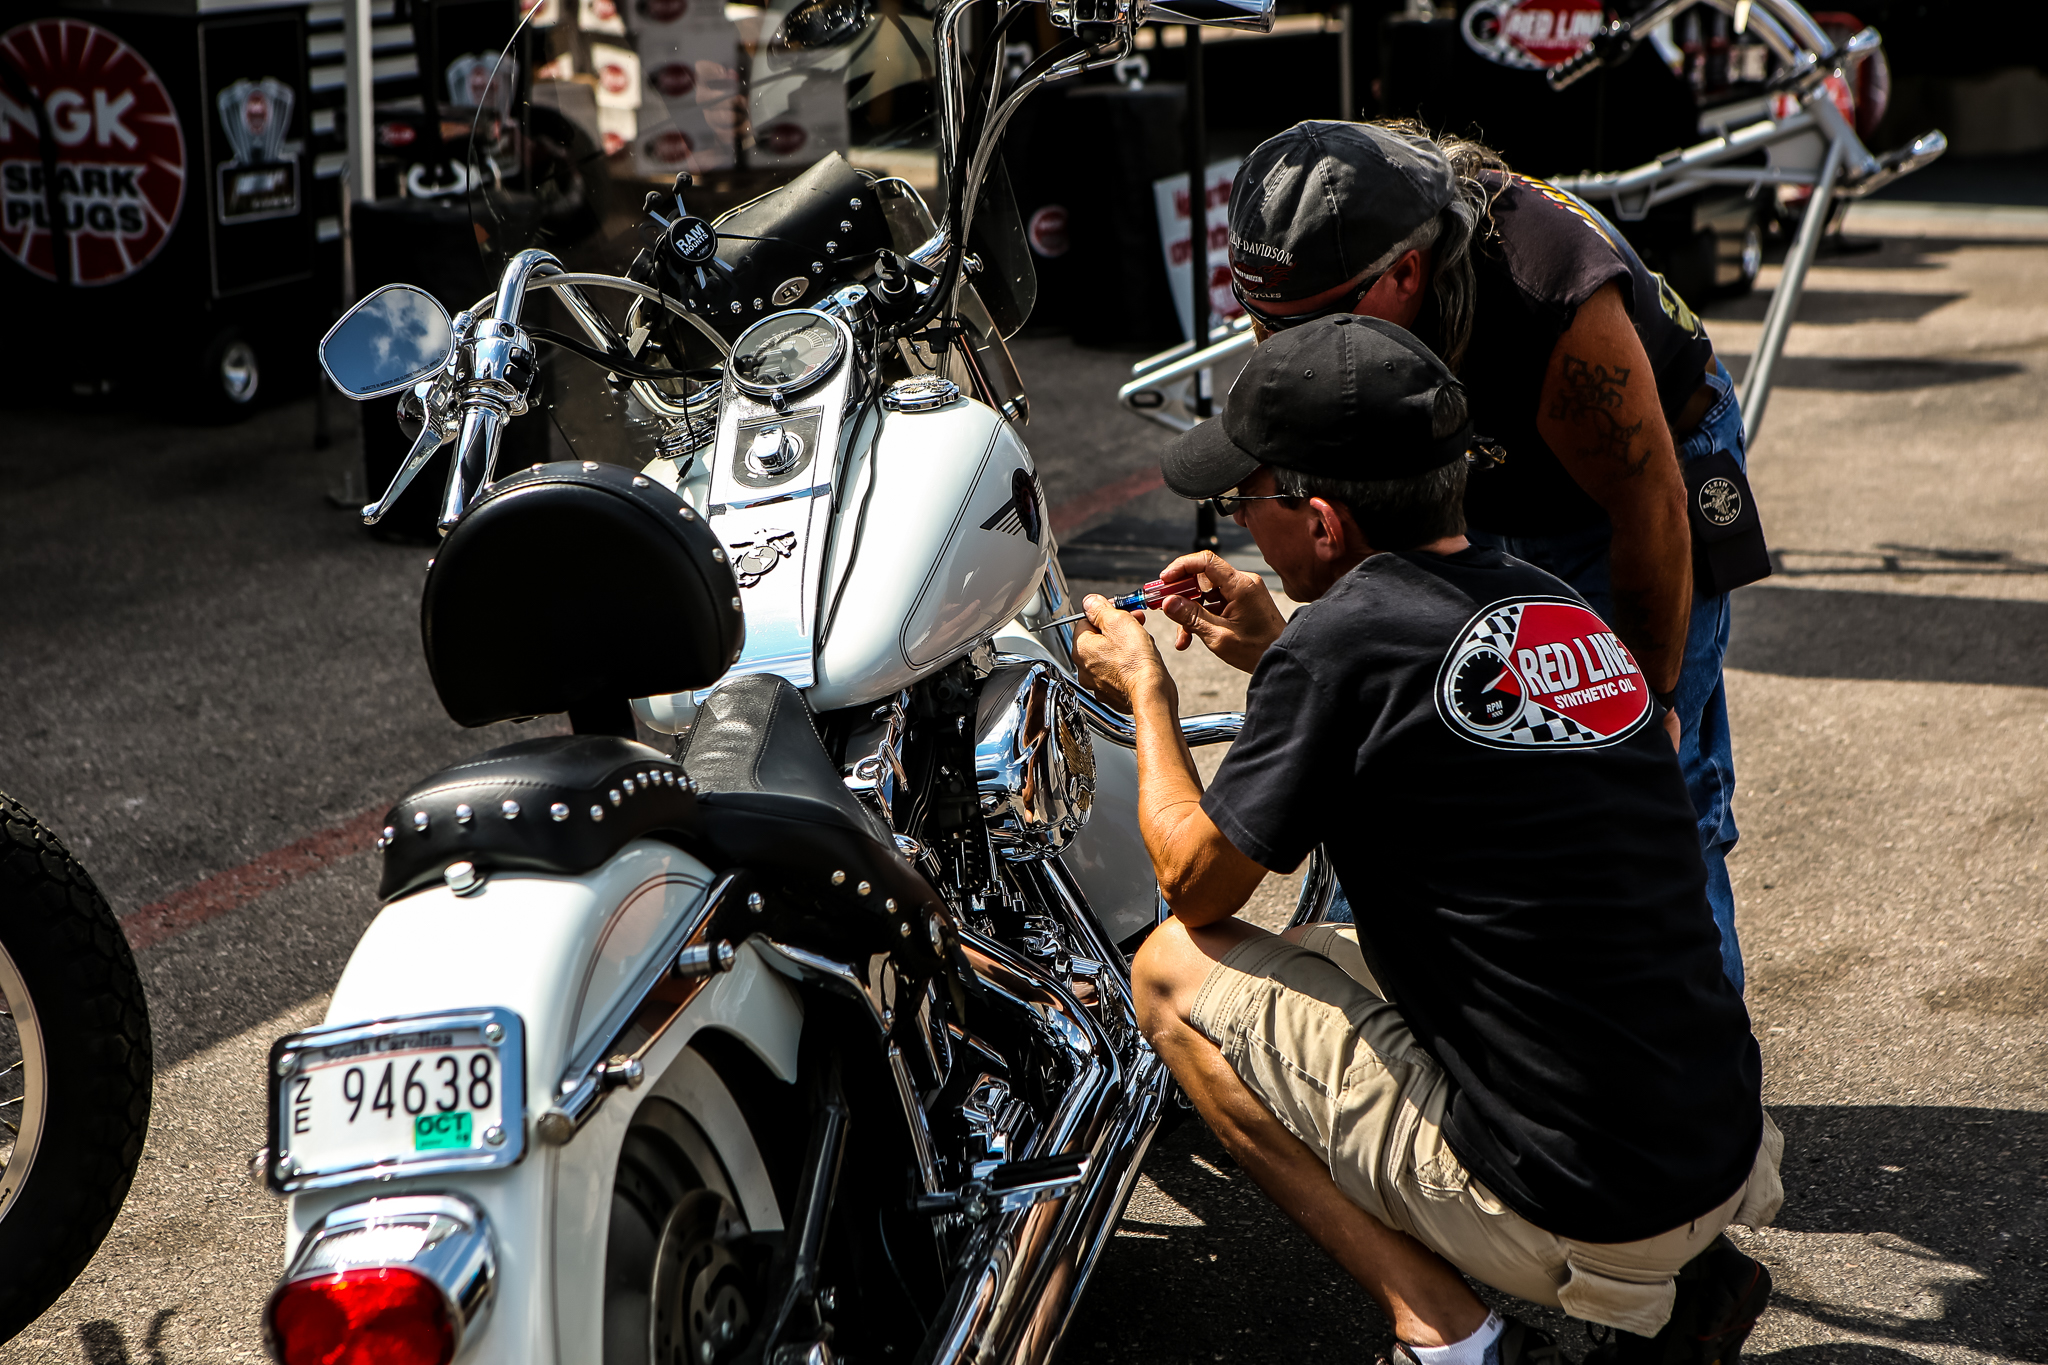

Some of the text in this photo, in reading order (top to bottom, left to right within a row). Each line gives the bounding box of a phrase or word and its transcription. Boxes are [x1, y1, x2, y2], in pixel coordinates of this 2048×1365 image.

[676, 223, 705, 251] RAM
[683, 232, 709, 256] MOUNTS
[1704, 481, 1728, 495] KLEIN
[1714, 508, 1737, 522] TOOLS
[1517, 632, 1639, 697] RED LINE
[1554, 678, 1638, 710] SYNTHETIC OIL
[1486, 700, 1503, 713] RPM
[343, 1052, 493, 1125] 94638
[417, 1112, 469, 1136] OCT
